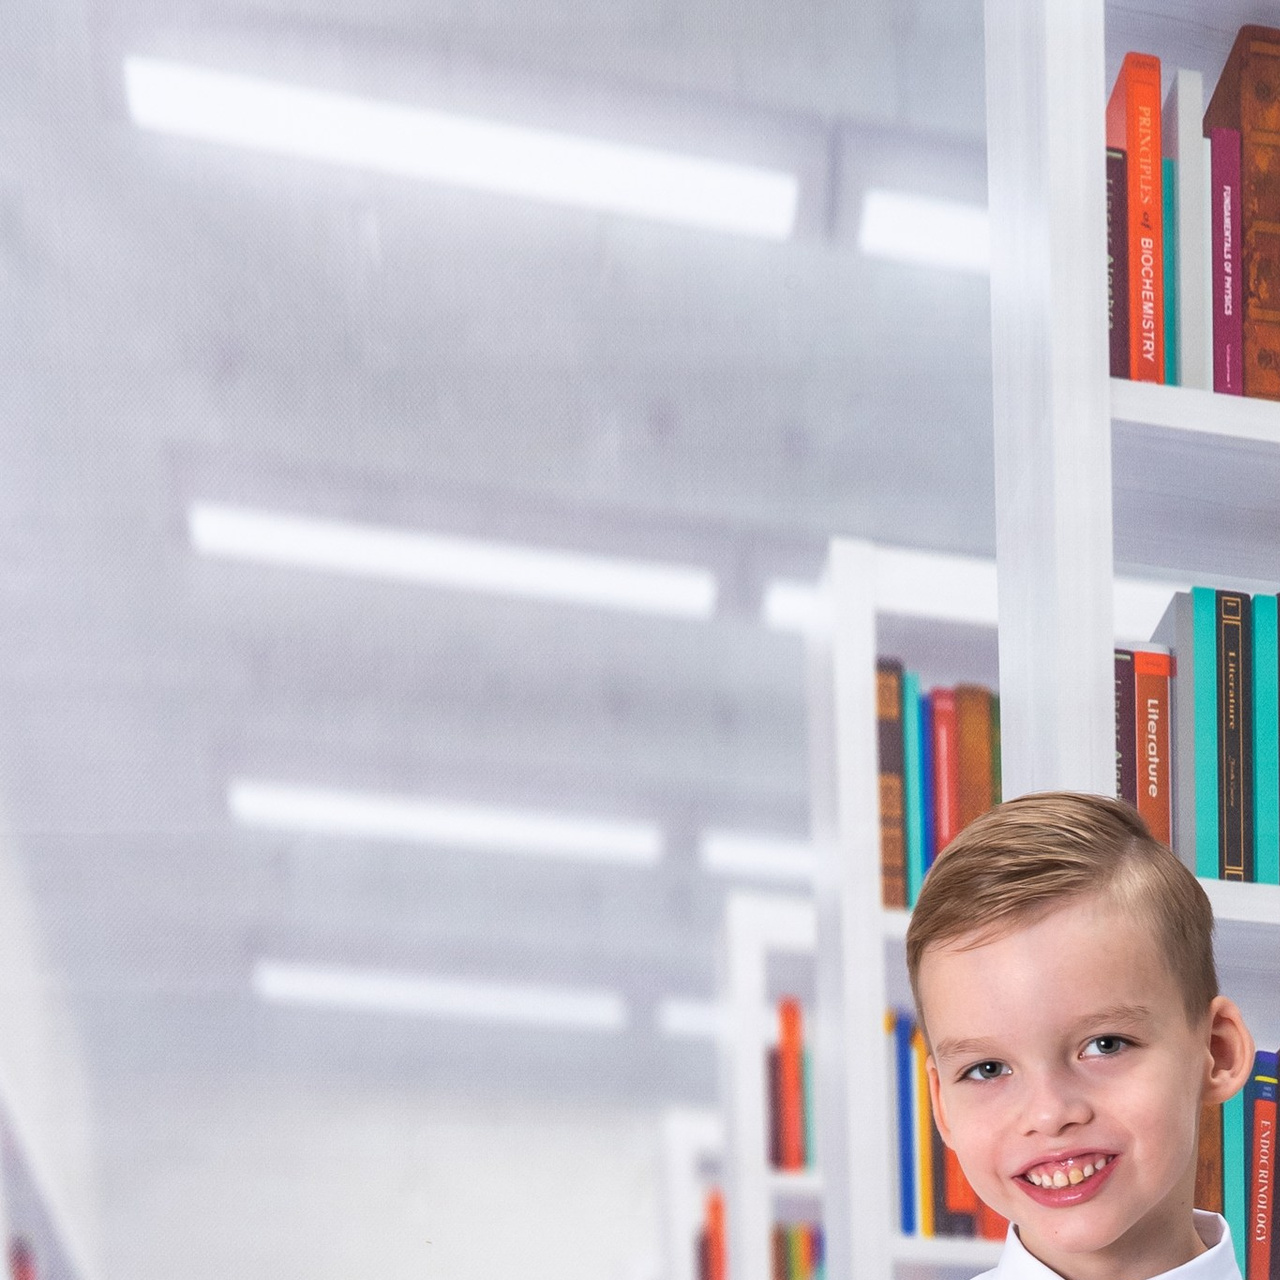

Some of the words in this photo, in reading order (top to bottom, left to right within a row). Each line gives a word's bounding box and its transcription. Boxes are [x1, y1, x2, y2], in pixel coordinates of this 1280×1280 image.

[1140, 237, 1154, 362] BIOCHEMISTRY
[1228, 651, 1236, 730] Literature
[1147, 698, 1160, 798] Literature
[1255, 1119, 1271, 1243] ENDOCRINOLOGY
